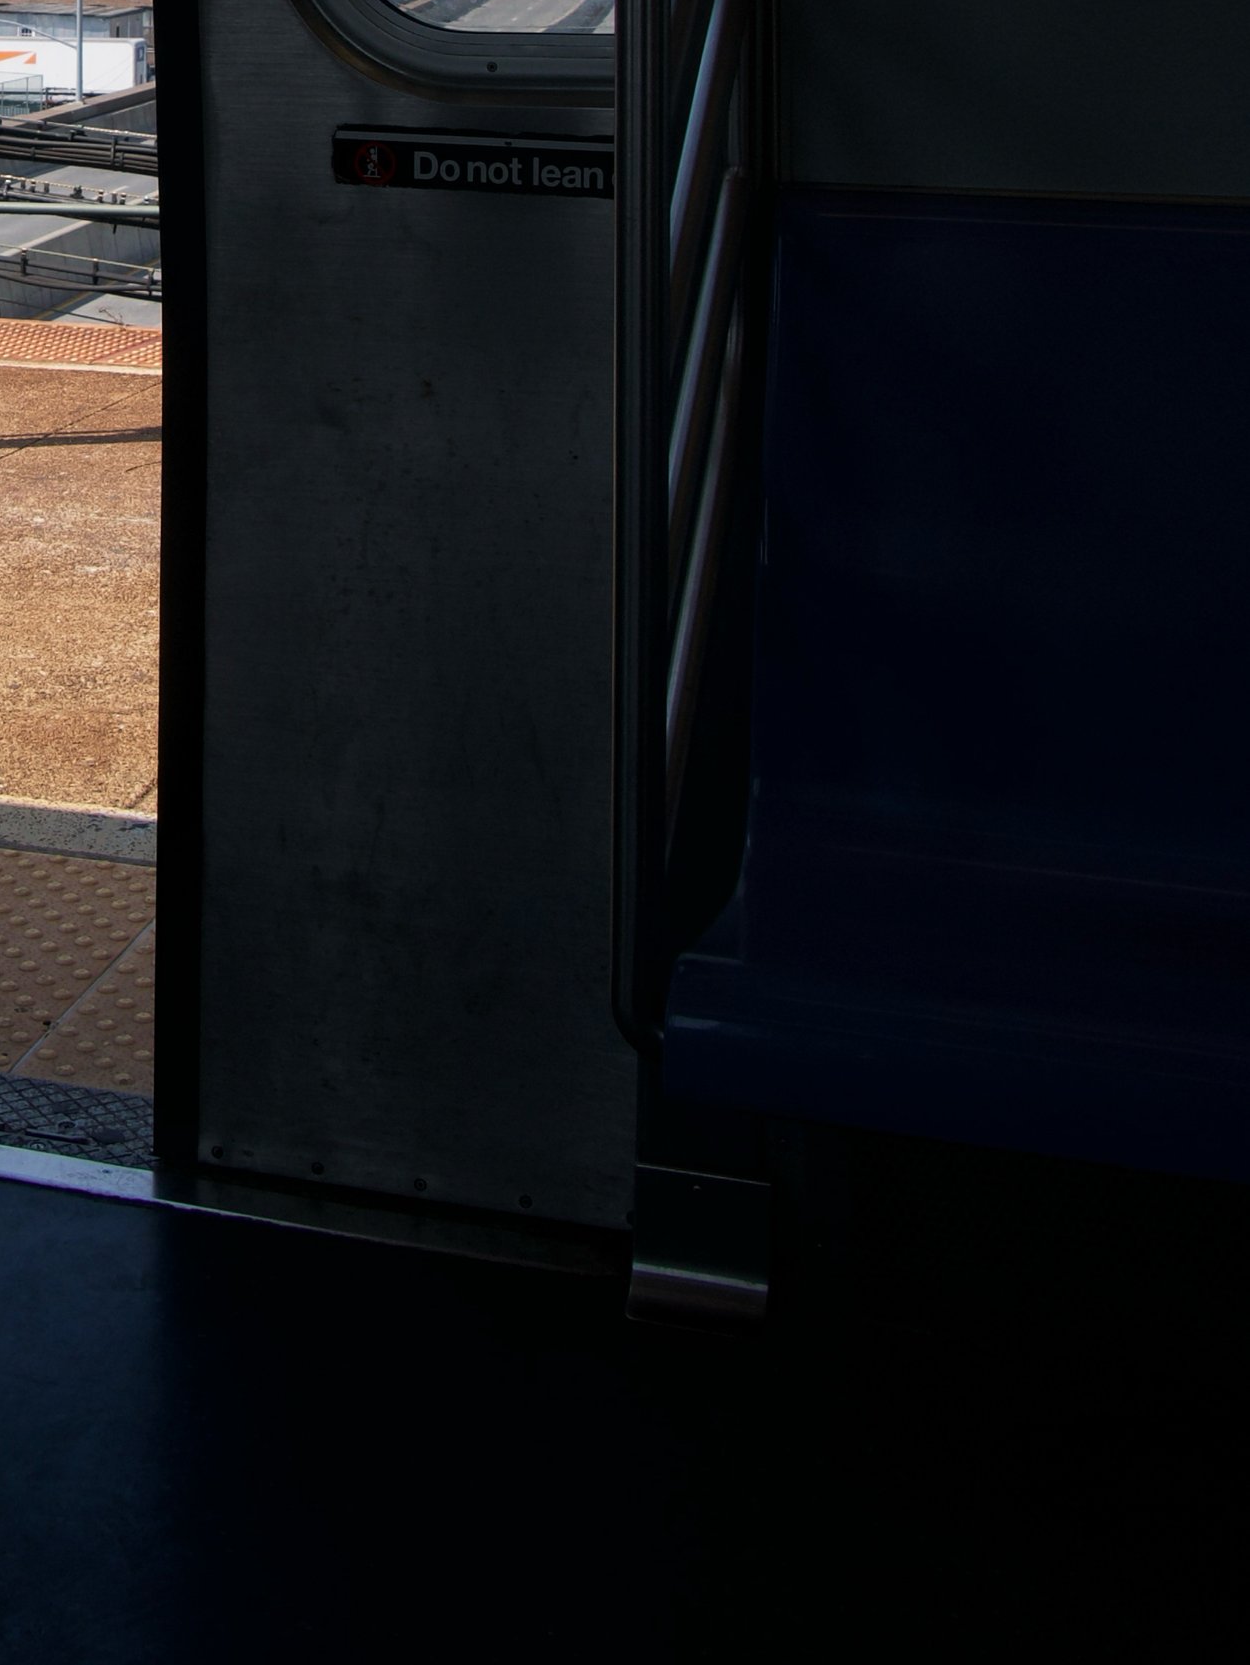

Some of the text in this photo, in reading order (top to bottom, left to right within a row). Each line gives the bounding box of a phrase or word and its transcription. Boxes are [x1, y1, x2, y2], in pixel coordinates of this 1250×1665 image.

[414, 151, 460, 181] Do
[467, 157, 523, 185] not
[533, 157, 604, 189] lean
